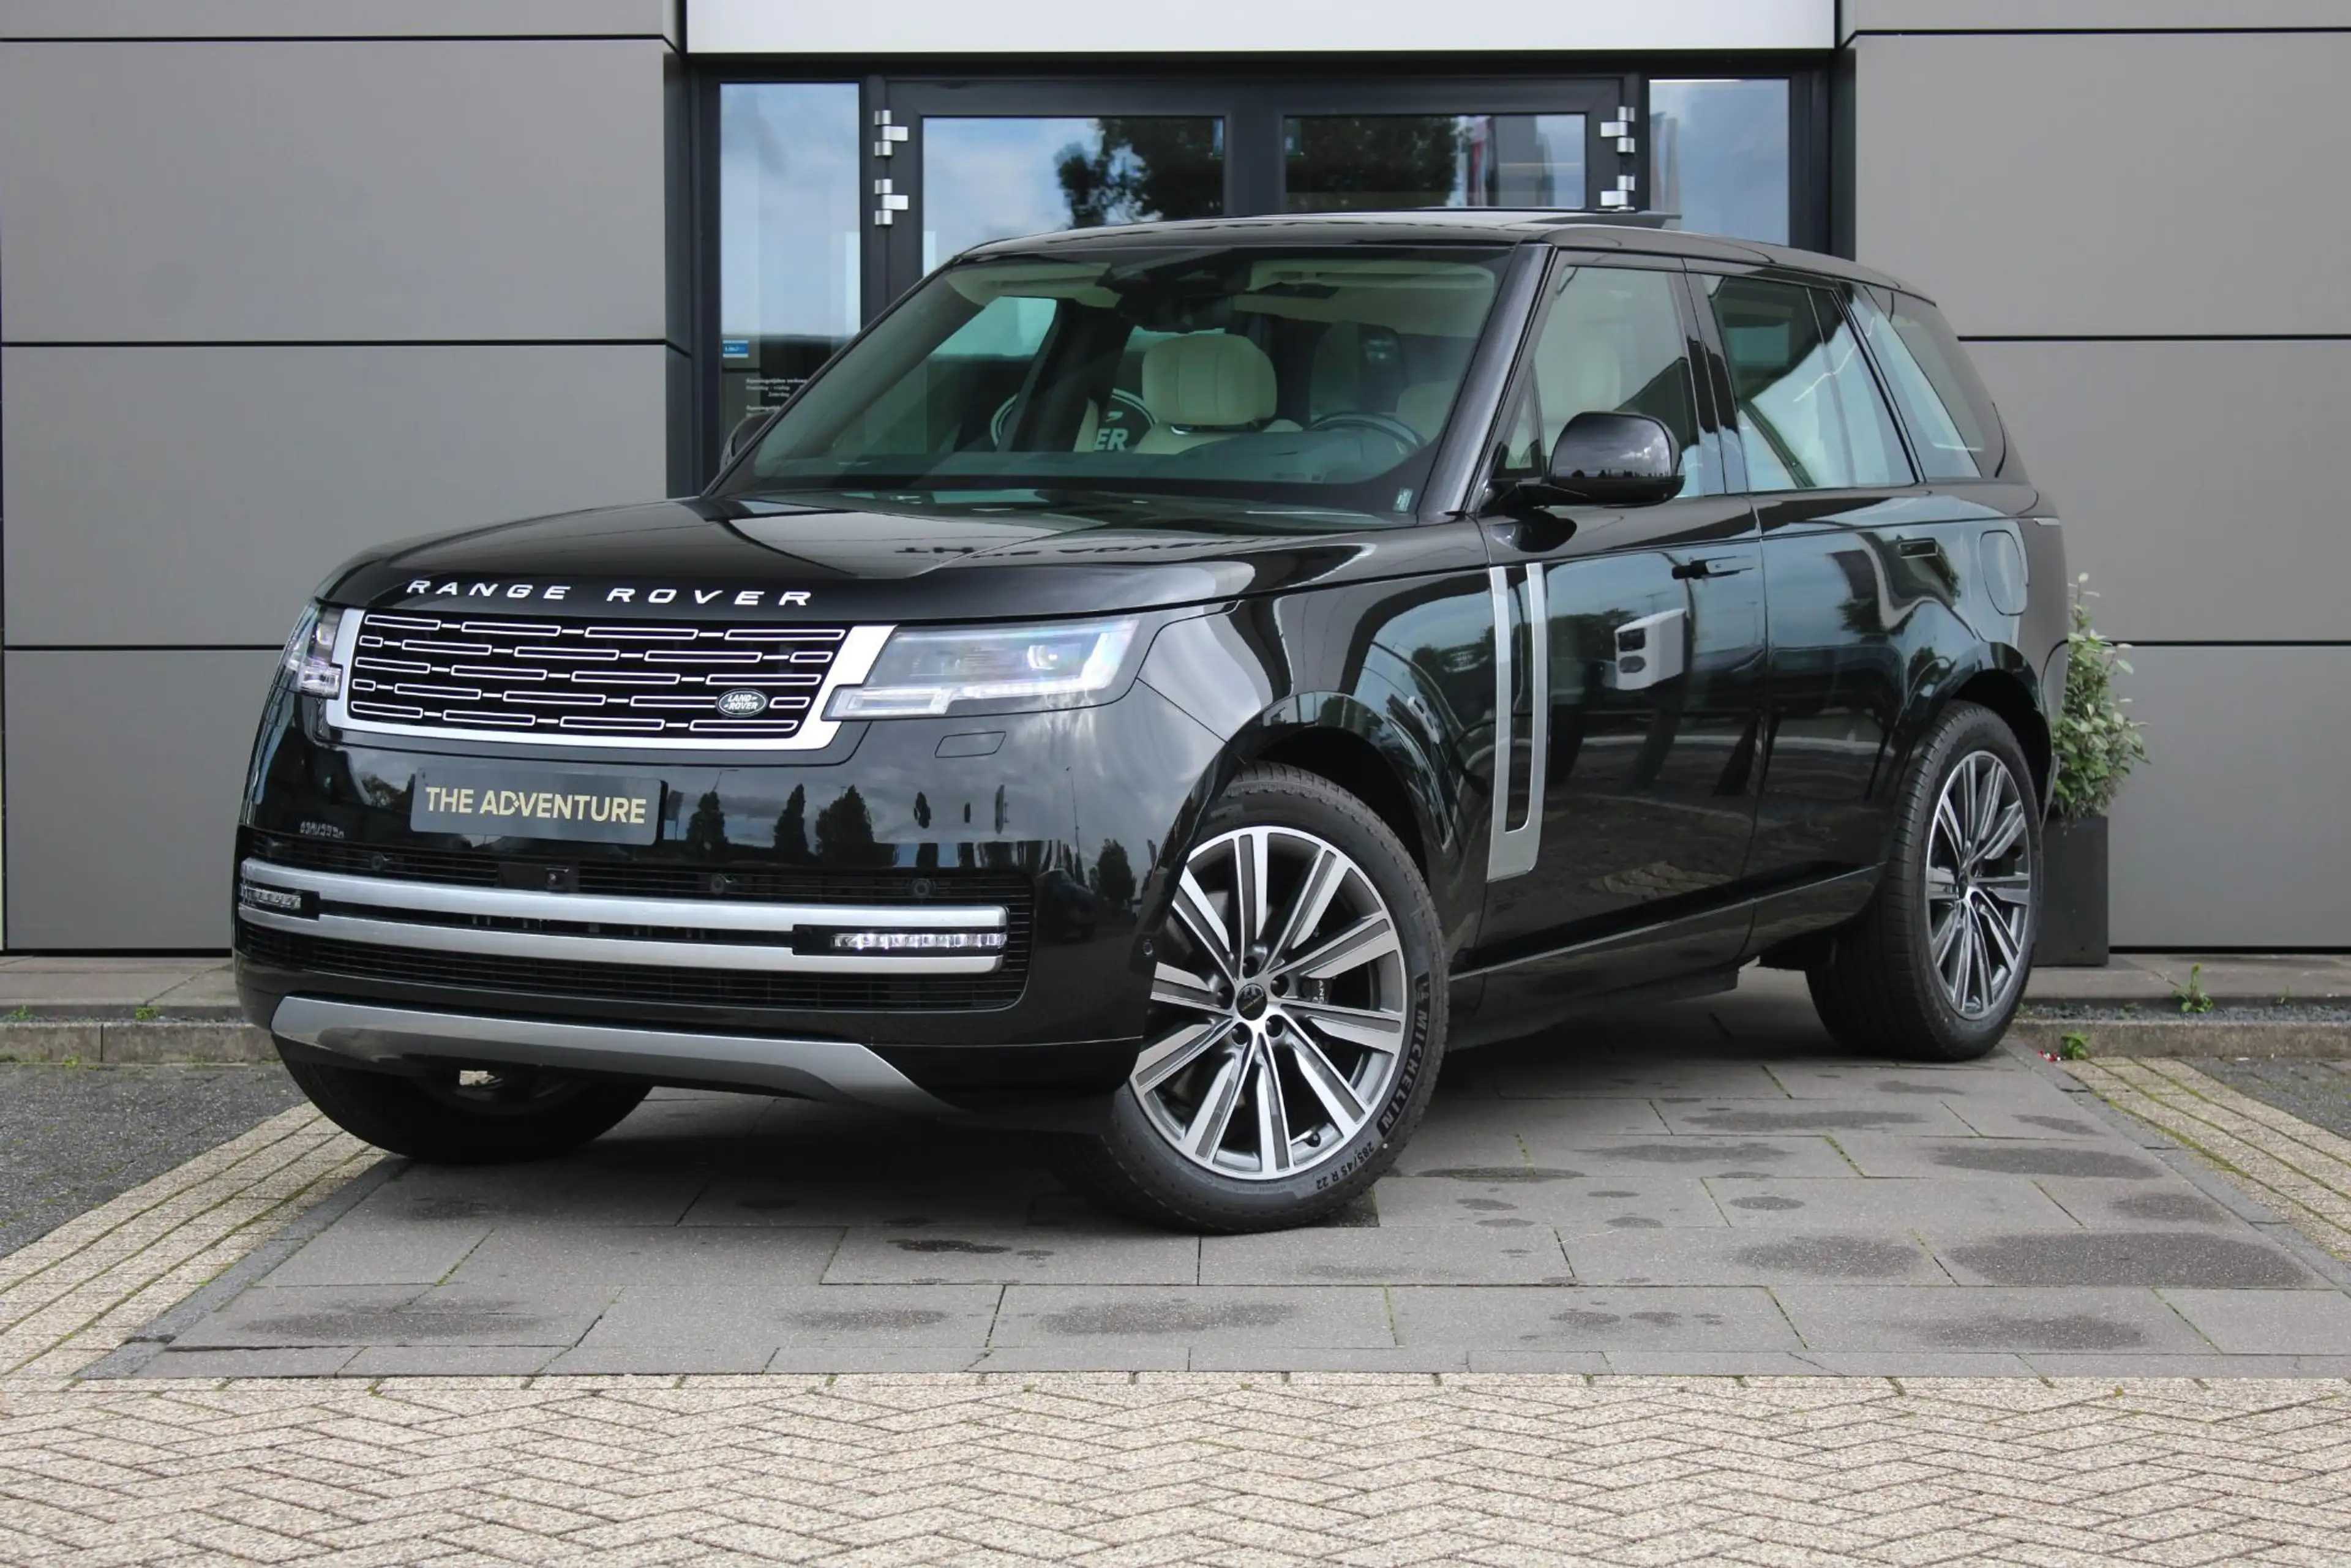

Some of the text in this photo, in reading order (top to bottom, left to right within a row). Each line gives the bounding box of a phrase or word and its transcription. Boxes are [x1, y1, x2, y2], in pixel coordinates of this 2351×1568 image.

[406, 580, 811, 606] RANGE ROVER
[728, 702, 758, 710] ROVER
[426, 787, 647, 824] THE ADVENTURE
[1381, 1010, 1428, 1129] MICHELIN
[1316, 1176, 1329, 1190] 22
